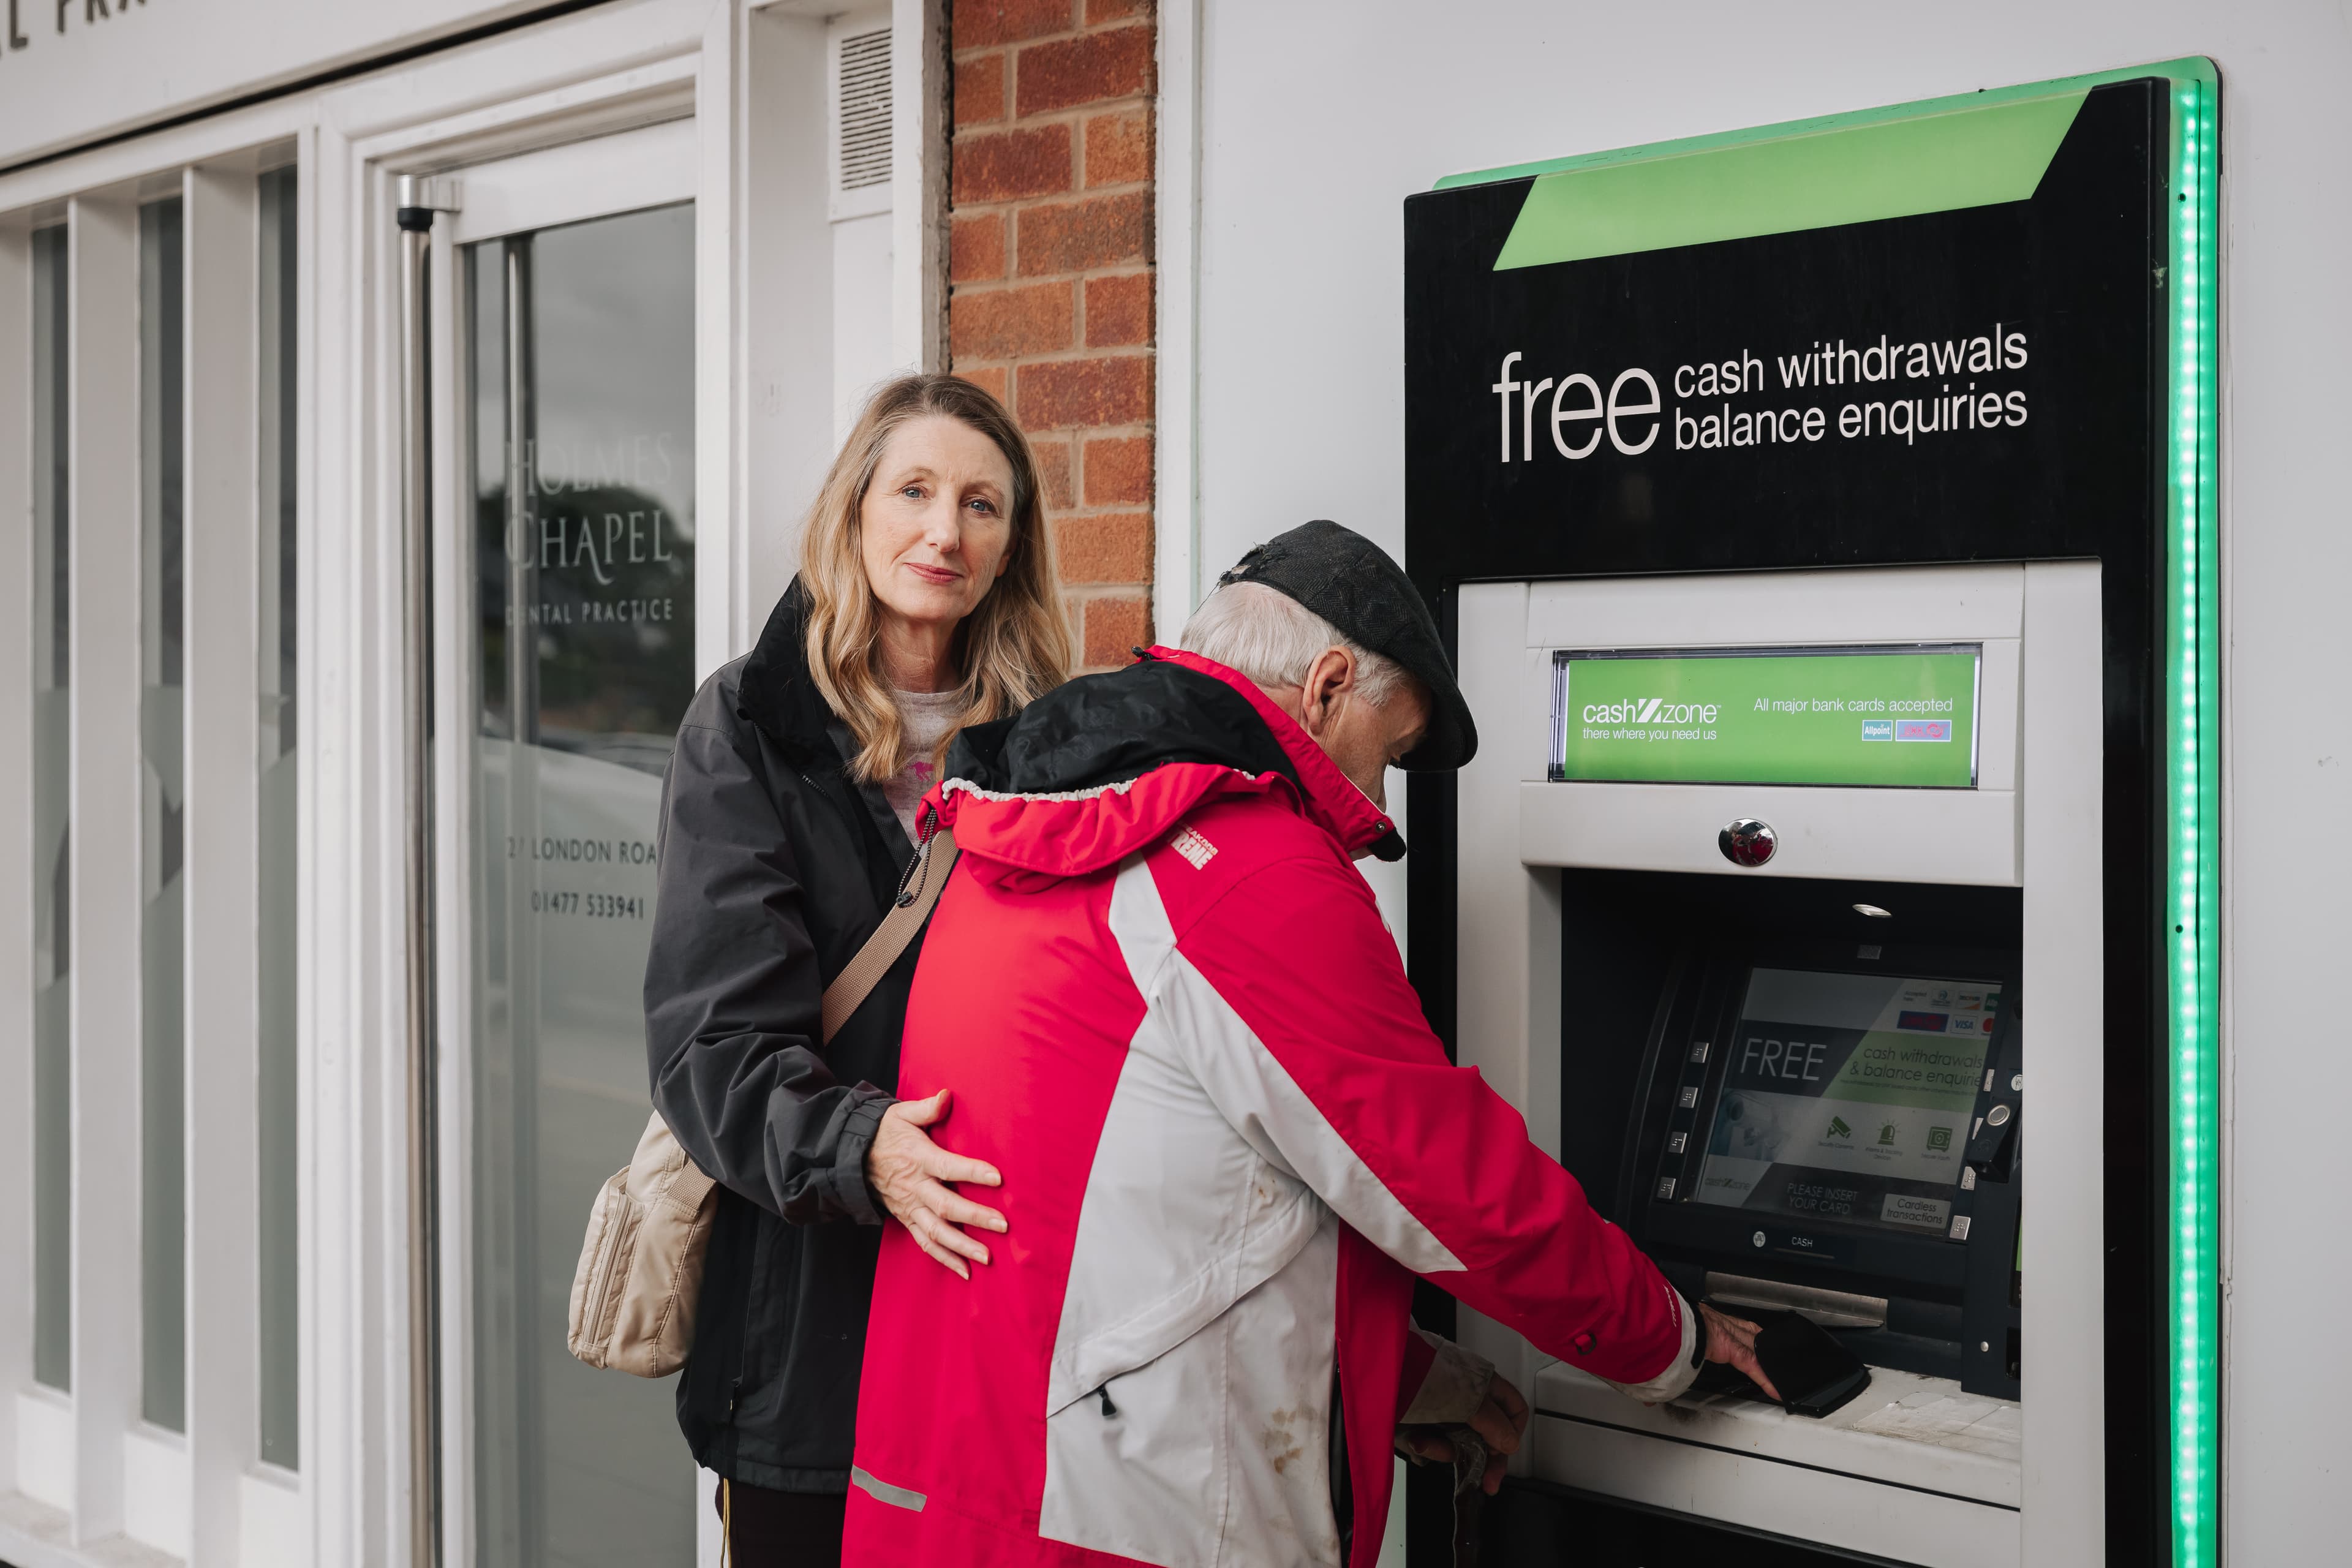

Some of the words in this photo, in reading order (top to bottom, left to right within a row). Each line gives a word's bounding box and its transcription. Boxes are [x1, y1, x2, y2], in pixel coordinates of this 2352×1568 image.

[1675, 349, 1763, 398] cash
[1777, 323, 2028, 390] withdrawals
[1492, 351, 1660, 463] free
[1676, 406, 1825, 450] balance
[1839, 382, 2028, 446] enquiries
[505, 432, 672, 497] HOLMES
[505, 509, 673, 585] CHAPEL
[582, 598, 673, 623] PRACTICE
[1754, 698, 1768, 711] All
[1773, 698, 1809, 714] major
[1812, 698, 1844, 711] bank
[1848, 698, 1885, 712] cards
[1889, 698, 1953, 714] accepted
[1583, 727, 1610, 739] there
[1613, 727, 1646, 739] where
[1648, 729, 1668, 742] you
[1672, 728, 1700, 739] need
[1703, 729, 1717, 740] us
[1864, 725, 1890, 736] Allpoint
[531, 837, 611, 862] LONDON
[619, 841, 657, 865] ROA
[531, 891, 579, 914] 01477
[586, 893, 644, 920] 533941
[1954, 1020, 1974, 1030] VISA
[1740, 1038, 1827, 1081] FREE
[1863, 1047, 1896, 1060] cash
[1901, 1049, 1983, 1069] withdrawals
[1850, 1061, 1859, 1076] &
[1864, 1063, 1922, 1081] balance
[1926, 1070, 1980, 1088] enquirie
[1787, 1183, 1823, 1197] PLEASE
[1825, 1188, 1858, 1201] INSERT
[1789, 1197, 1817, 1211] YOUR
[1819, 1200, 1850, 1215] CARD
[1887, 1208, 1942, 1224] transactions
[1898, 1199, 1936, 1212] Cardless
[1792, 1237, 1813, 1248] CASH
